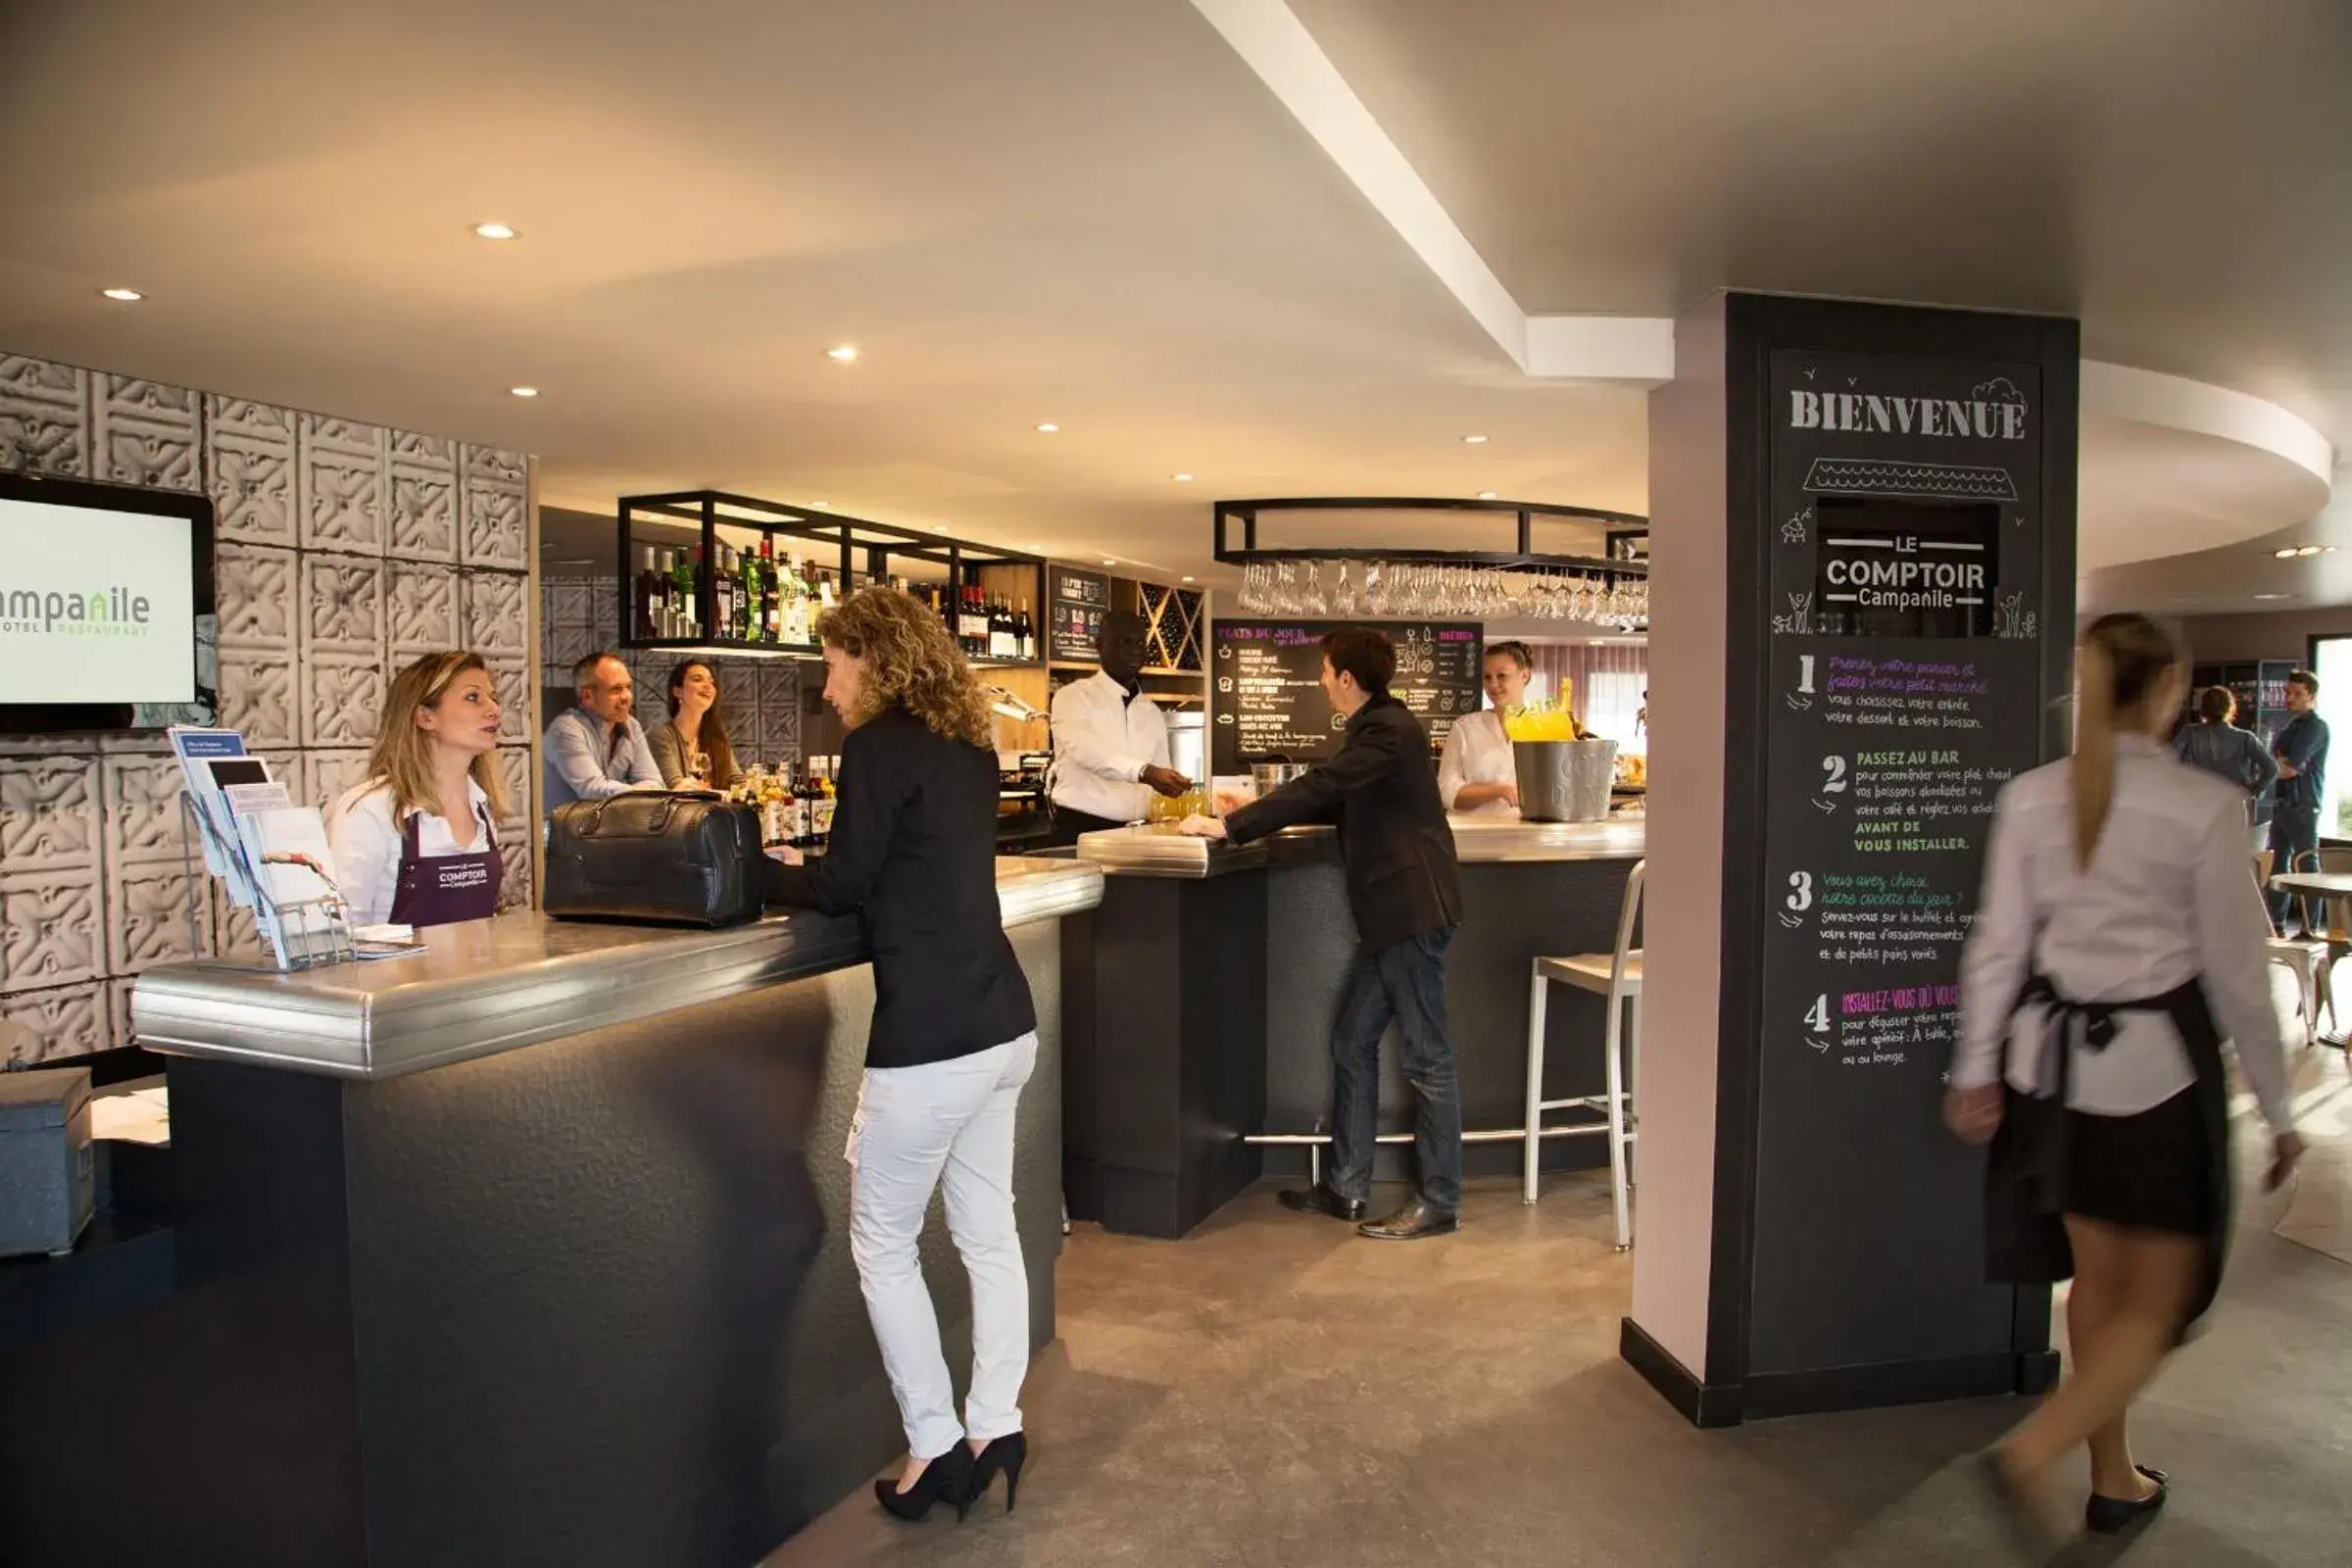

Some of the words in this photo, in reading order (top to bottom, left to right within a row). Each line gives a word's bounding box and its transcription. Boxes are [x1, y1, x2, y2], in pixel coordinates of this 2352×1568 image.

[1790, 390, 2026, 440] BIENVENUE
[1896, 537, 1917, 553] LE
[1827, 559, 1984, 589] COMPTOIR
[1858, 588, 1953, 612] Campanile
[0, 587, 150, 633] mpanile
[1797, 655, 1816, 694] 1
[1856, 695, 1905, 709] choisissez
[1908, 698, 1934, 710] votre
[1825, 712, 1853, 723] votre
[1857, 710, 1893, 726] dessert
[1898, 713, 1909, 727] et
[1913, 713, 1937, 727] votre
[1942, 714, 1983, 729] boisson.
[1856, 751, 1905, 766] PASSEZ
[1907, 750, 1926, 764] AU
[1930, 750, 1960, 764] BAR
[1822, 754, 1847, 794] 2
[1855, 770, 1877, 788] pour
[1881, 767, 1933, 782] commander
[1936, 769, 1961, 781] votre
[1963, 767, 1983, 786] plat
[1854, 786, 1871, 799] vos
[1874, 784, 1916, 800] boissons
[1854, 803, 1880, 816] votre
[1883, 802, 1902, 816] café
[1906, 803, 1918, 815] et
[1920, 801, 1949, 820] réglez
[1951, 803, 1968, 815] vos
[1854, 821, 1899, 836] AVANT
[1902, 820, 1921, 833] DE
[1853, 838, 1892, 853] VOUS
[1896, 838, 1970, 852] INSTALLER.
[439, 869, 487, 882] COMPTOIR
[1855, 874, 1886, 893] avez
[1787, 870, 1812, 911] 3
[1821, 910, 1879, 925] Servez-vous
[1883, 912, 1897, 924] sur
[1899, 910, 1911, 923] le
[1912, 911, 1942, 926] buffet
[1944, 912, 1956, 924] et
[1819, 929, 1847, 941] votre
[1849, 931, 1877, 945] repas
[1879, 929, 1964, 943] d'assaisonnements
[1819, 949, 1831, 960] et
[1835, 948, 1847, 960] de
[1849, 948, 1881, 964] petits
[1883, 948, 1909, 965] pains
[1804, 993, 1831, 1033] 4
[1841, 1017, 1865, 1036] pour
[1868, 1015, 1909, 1031] déguster
[1913, 1012, 1938, 1024] votre
[1840, 1037, 1868, 1049] votre
[1857, 1054, 1870, 1065] au
[1873, 1052, 1907, 1066] lounge.
